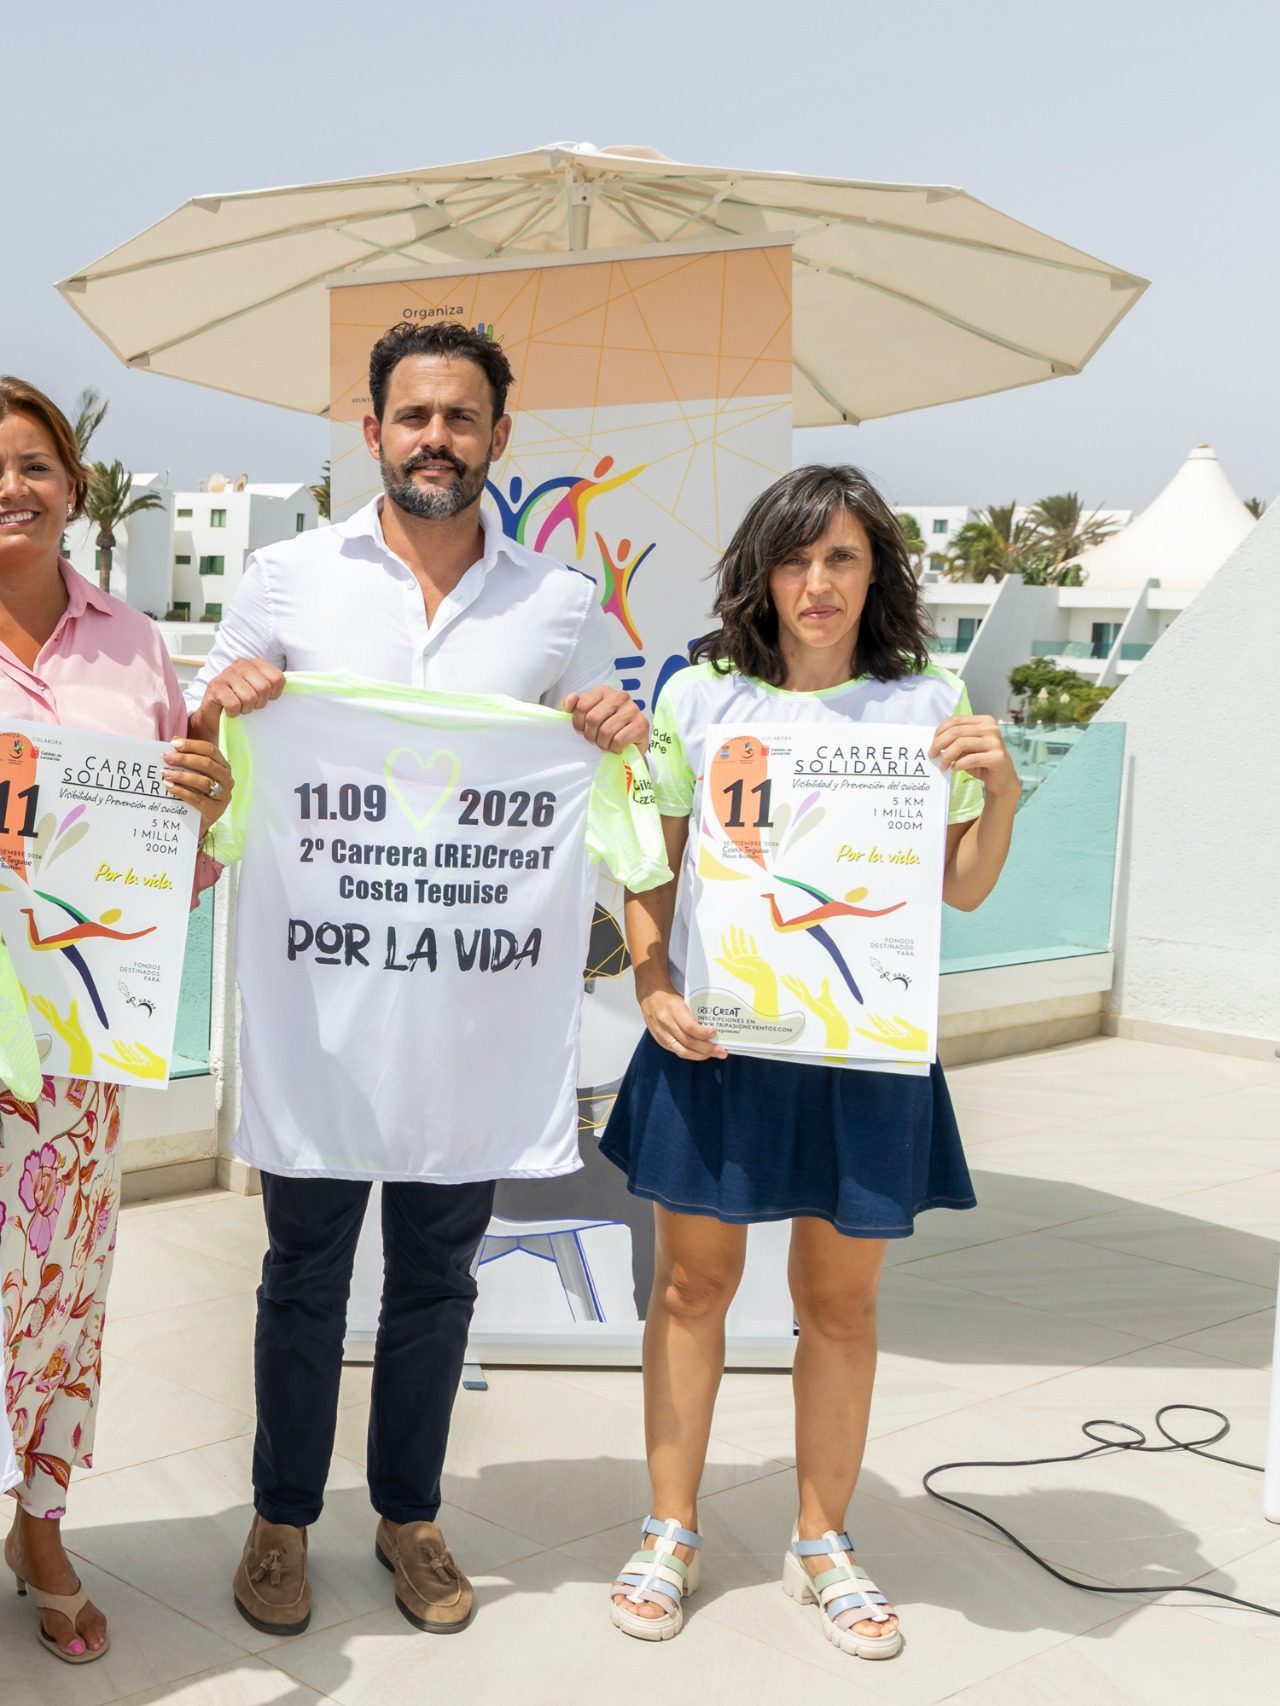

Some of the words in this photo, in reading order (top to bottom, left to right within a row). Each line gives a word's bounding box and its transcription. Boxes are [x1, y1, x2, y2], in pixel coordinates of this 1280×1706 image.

[402, 305, 464, 320] Organiza
[816, 746, 926, 760] CARRERA
[85, 756, 164, 780] CARRE
[794, 759, 925, 775] SOLIDARIA
[887, 780, 899, 790] del
[901, 781, 931, 791] suicidio
[59, 787, 99, 802] Visibilidad
[105, 795, 147, 810] Prevención
[148, 802, 160, 812] del
[161, 805, 188, 816] suicidio
[294, 782, 387, 822] 11.09
[458, 788, 557, 828] 2026
[723, 779, 774, 828] 11
[893, 797, 899, 806] 5
[905, 797, 924, 807] KM
[883, 809, 924, 818] MILLA
[152, 819, 157, 827] 5
[162, 820, 180, 831] KM
[888, 821, 923, 830] 200M
[141, 830, 179, 843] MILLA
[145, 843, 178, 855] 200M
[331, 839, 428, 867] Carrera
[434, 843, 555, 869] (RE)CreaT
[835, 842, 865, 863] Por
[867, 845, 884, 863] la
[888, 847, 920, 865] vida
[94, 862, 122, 882] Por
[124, 865, 139, 885] la
[143, 872, 173, 890] vida
[339, 875, 408, 902] Costa
[415, 879, 508, 907] Teguise
[287, 918, 371, 967] POR
[383, 926, 437, 973] LA
[454, 927, 542, 973] VIDA
[119, 966, 160, 976] DESTINADOS
[134, 961, 161, 971] FONDOS
